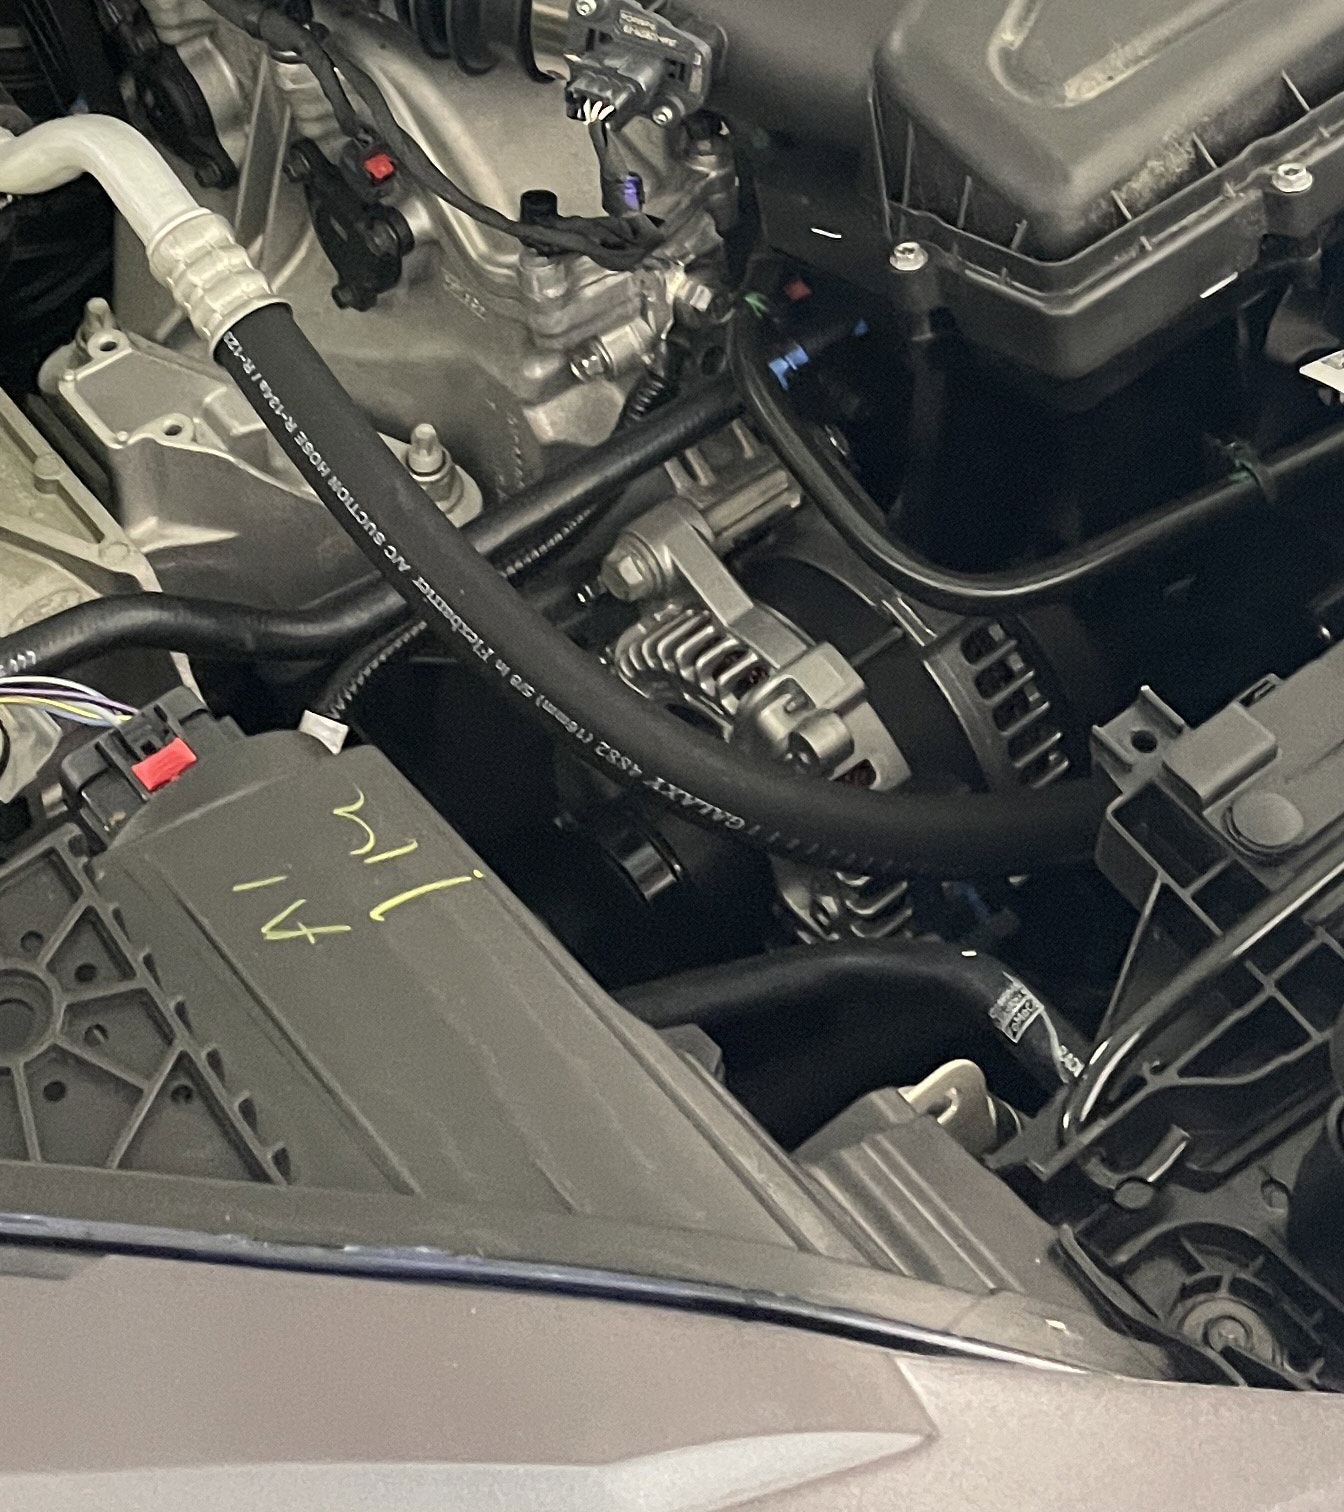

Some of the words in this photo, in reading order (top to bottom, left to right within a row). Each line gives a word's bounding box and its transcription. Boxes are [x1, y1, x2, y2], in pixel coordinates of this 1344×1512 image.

[294, 430, 331, 477] HOSE
[328, 475, 387, 546] SUCTION
[643, 777, 745, 830] GALAXY
